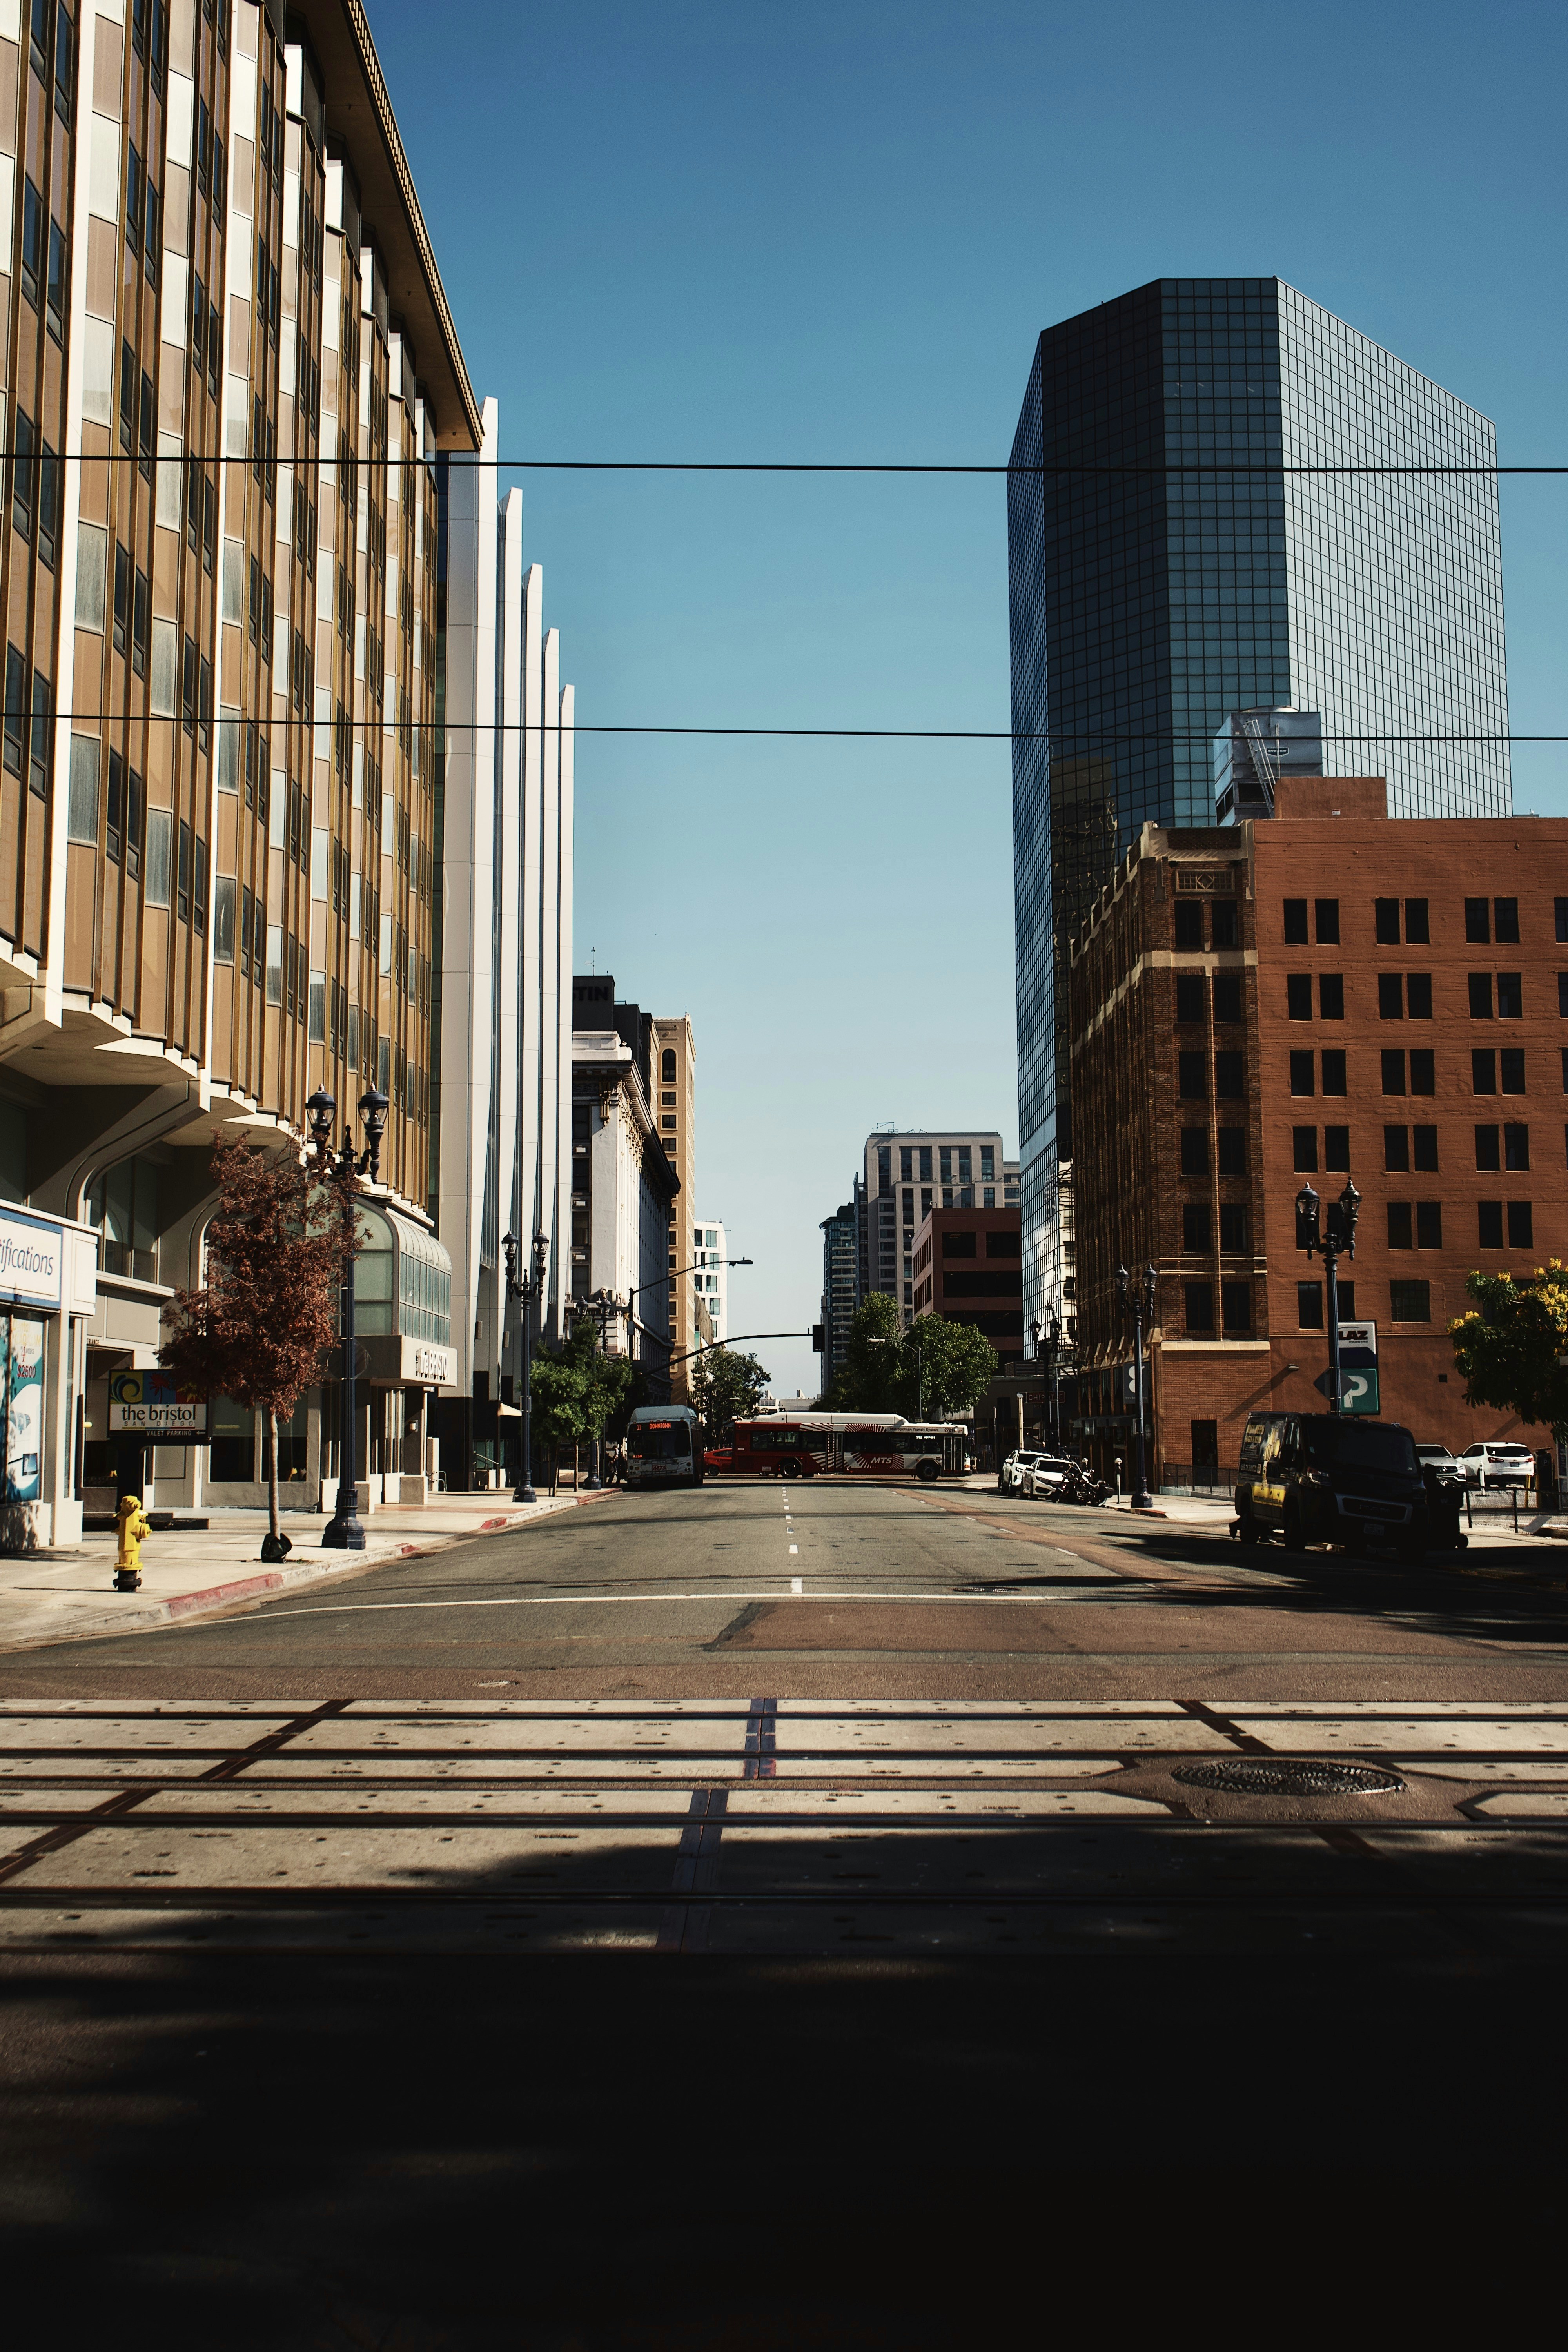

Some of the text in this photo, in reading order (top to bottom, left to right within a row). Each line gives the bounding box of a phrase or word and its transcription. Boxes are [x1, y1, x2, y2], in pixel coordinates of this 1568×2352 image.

[1338, 1330, 1368, 1340] LAZ
[17, 1364, 36, 1378] $2500
[122, 1405, 196, 1421] the bristol
